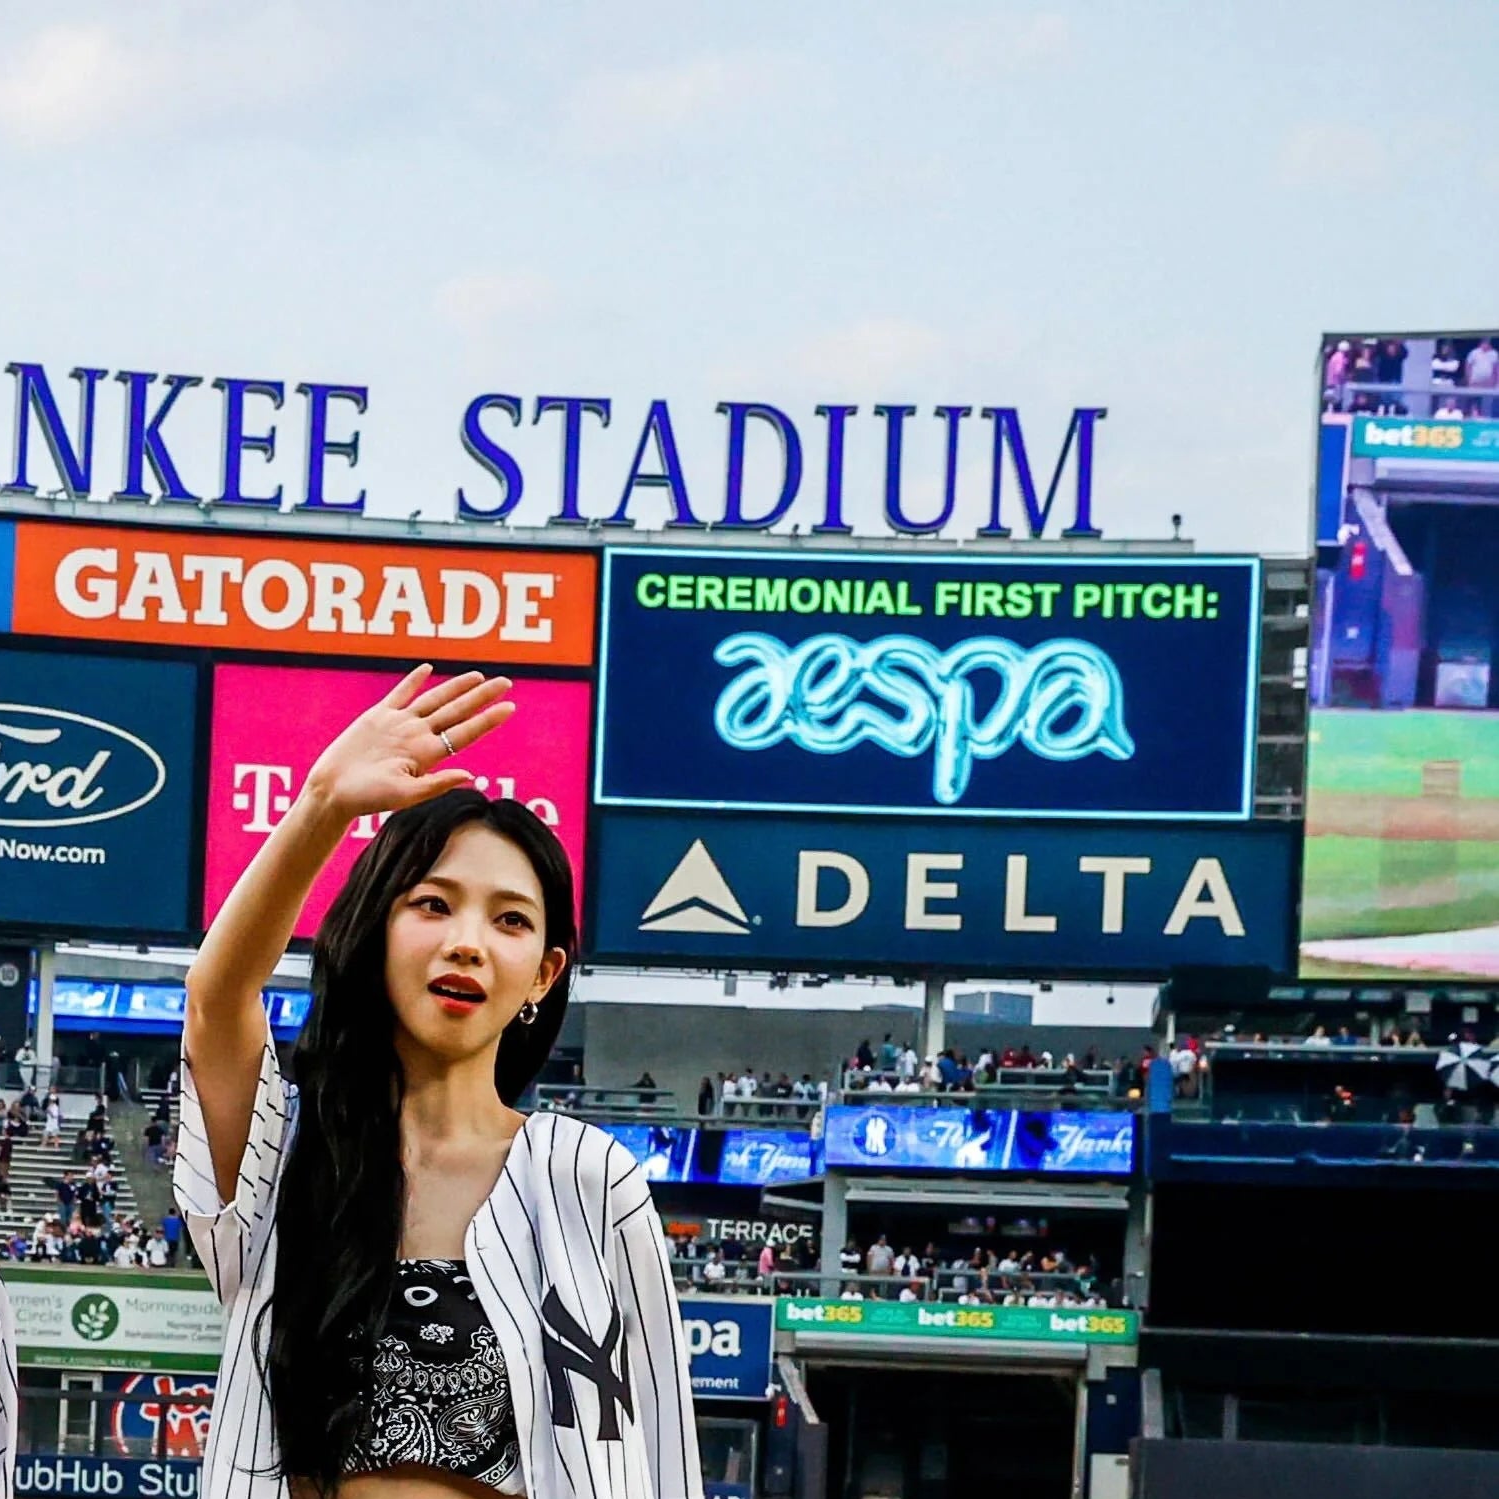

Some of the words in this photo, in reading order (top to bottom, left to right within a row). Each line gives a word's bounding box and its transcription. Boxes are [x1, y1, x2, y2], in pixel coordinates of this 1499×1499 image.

[1365, 422, 1463, 448] bet365
[458, 394, 1107, 539] STADIUM
[55, 548, 553, 643] GATORADE
[637, 573, 921, 616] CEREMONIAL
[935, 582, 1061, 618] FIRST
[1073, 583, 1219, 619] PITCH:
[714, 632, 1135, 804] aespa
[796, 850, 1245, 936] DELTA
[707, 1218, 813, 1245] TERRACE
[682, 1318, 741, 1365] pa
[787, 1303, 863, 1322] bet365
[918, 1307, 994, 1328] bet365
[1051, 1314, 1126, 1334] bet365
[691, 1375, 740, 1390] ement
[15, 1459, 124, 1494] ubHub
[138, 1463, 200, 1498] Stu
